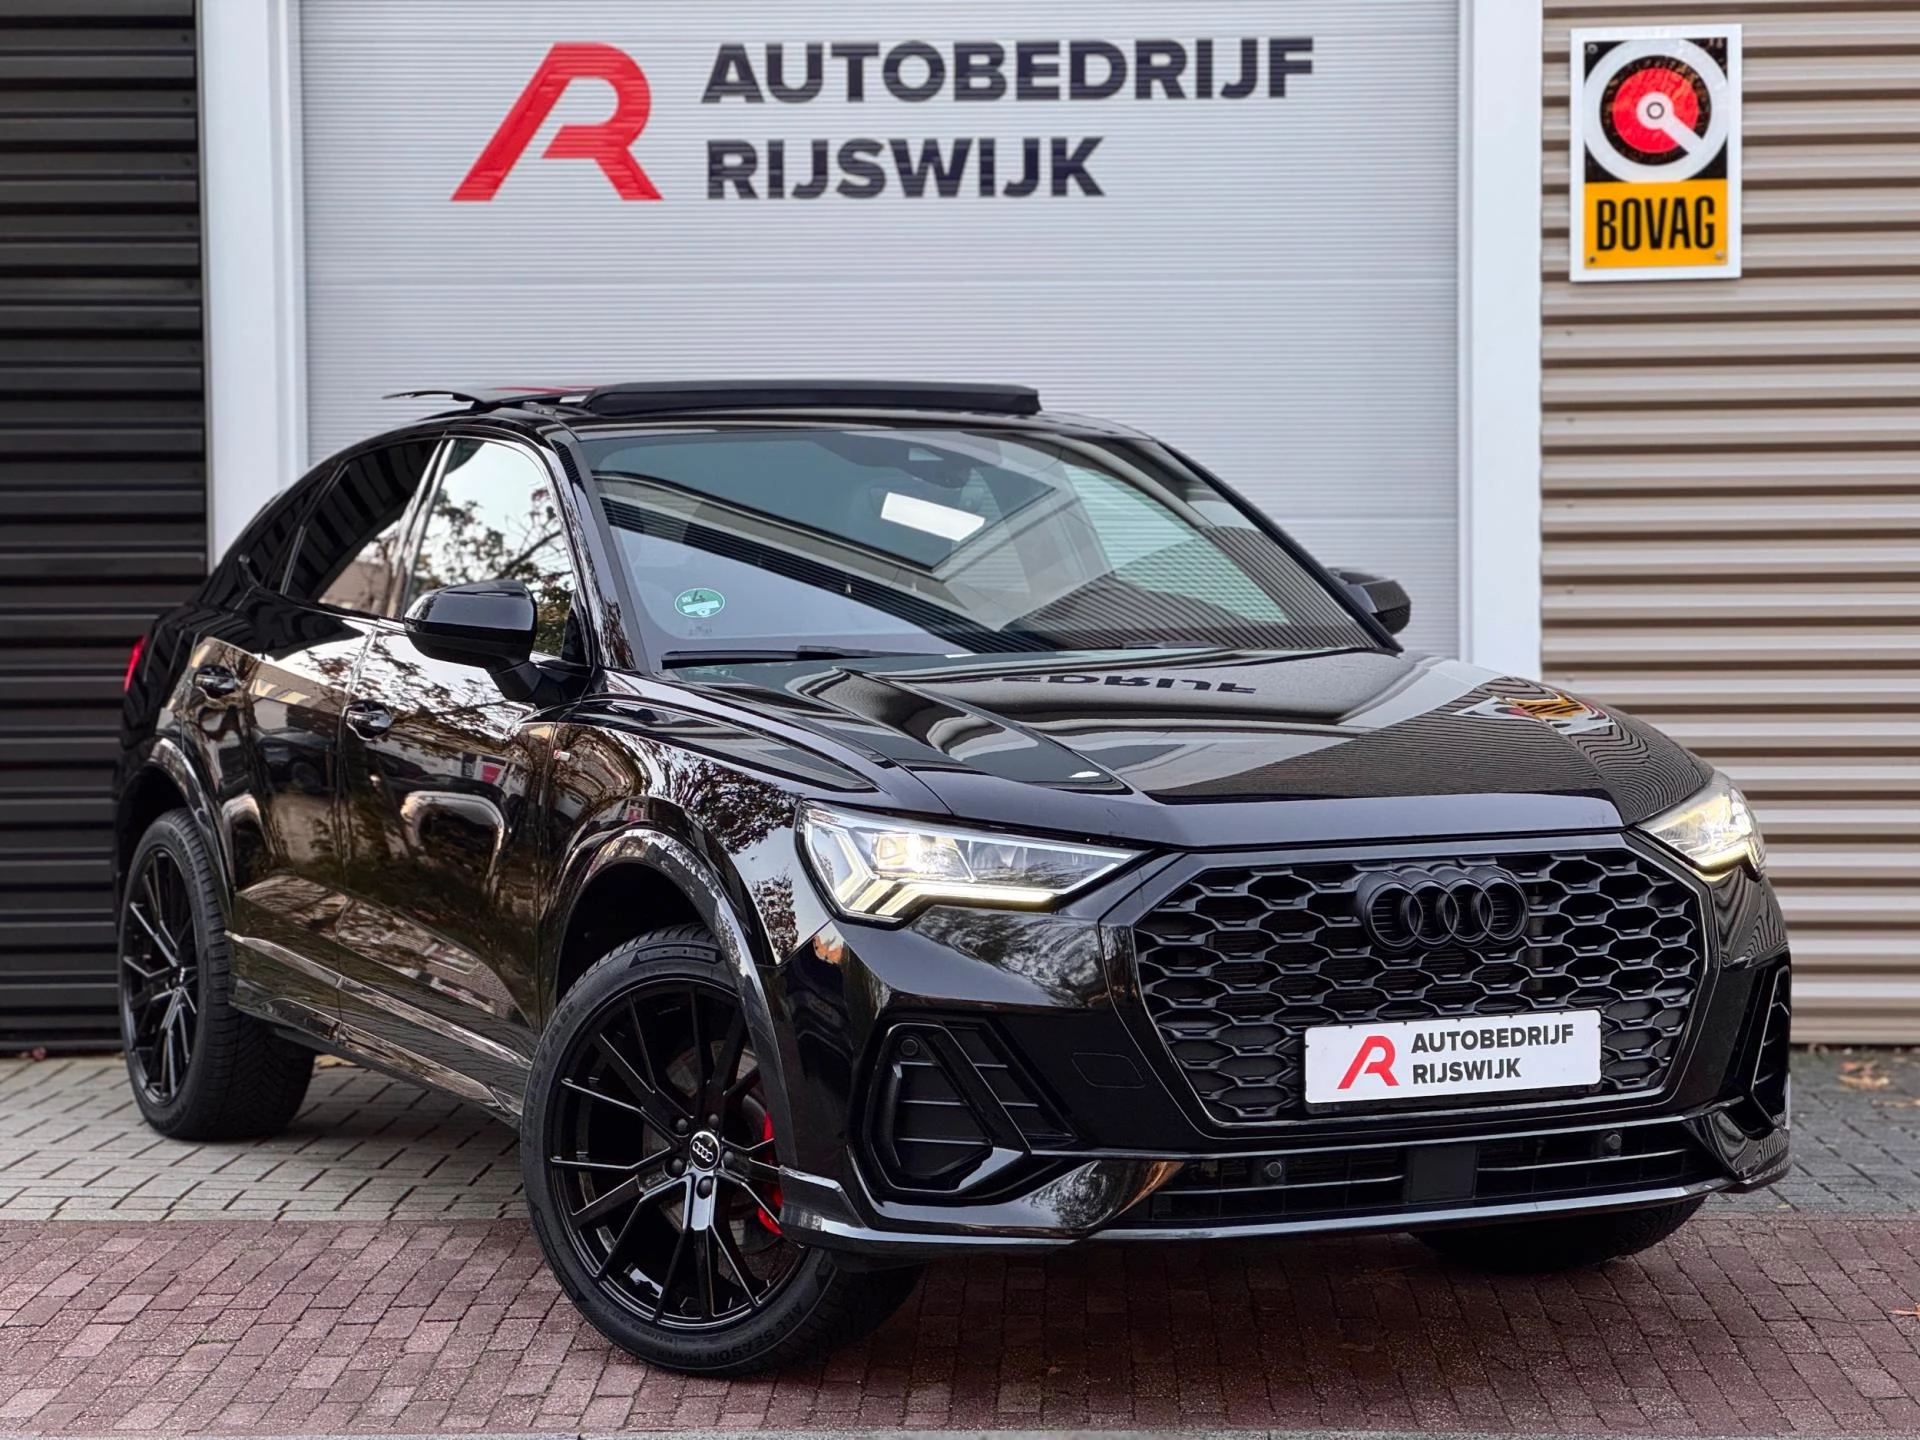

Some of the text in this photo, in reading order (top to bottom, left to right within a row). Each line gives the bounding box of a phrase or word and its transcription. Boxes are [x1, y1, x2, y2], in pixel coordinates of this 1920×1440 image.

[701, 36, 1314, 104] AUTOBEDRIJF
[706, 136, 1106, 201] RIJSWIJK
[1596, 195, 1715, 251] BOVAG
[1411, 1024, 1574, 1054] AUTOBEDRIJF
[1412, 1057, 1521, 1085] RIJSWIJK
[705, 1327, 776, 1364] SEASON
